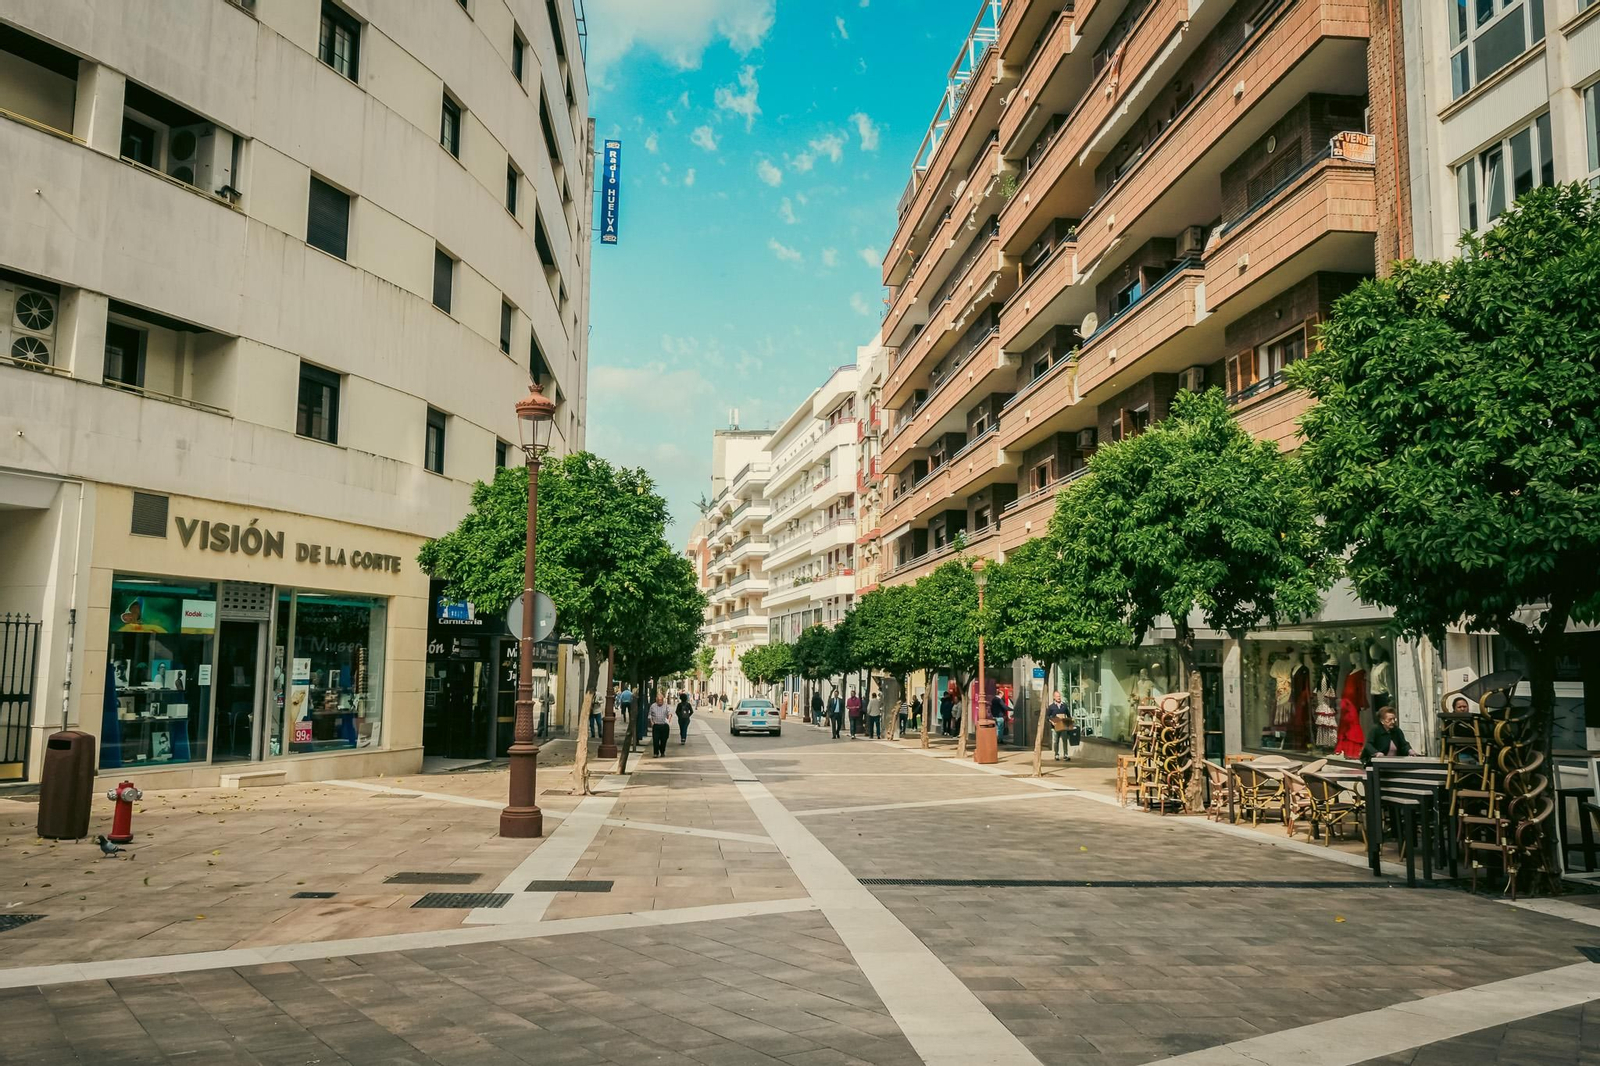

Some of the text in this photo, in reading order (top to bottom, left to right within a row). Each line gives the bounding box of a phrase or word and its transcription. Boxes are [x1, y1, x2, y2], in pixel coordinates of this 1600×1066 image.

[1344, 133, 1374, 146] VENDE
[609, 151, 617, 184] Radio
[606, 189, 616, 232] HUELVA
[174, 516, 402, 574] VISIÓN DE LA CORTE
[185, 610, 203, 618] Kodak
[428, 638, 445, 655] ón
